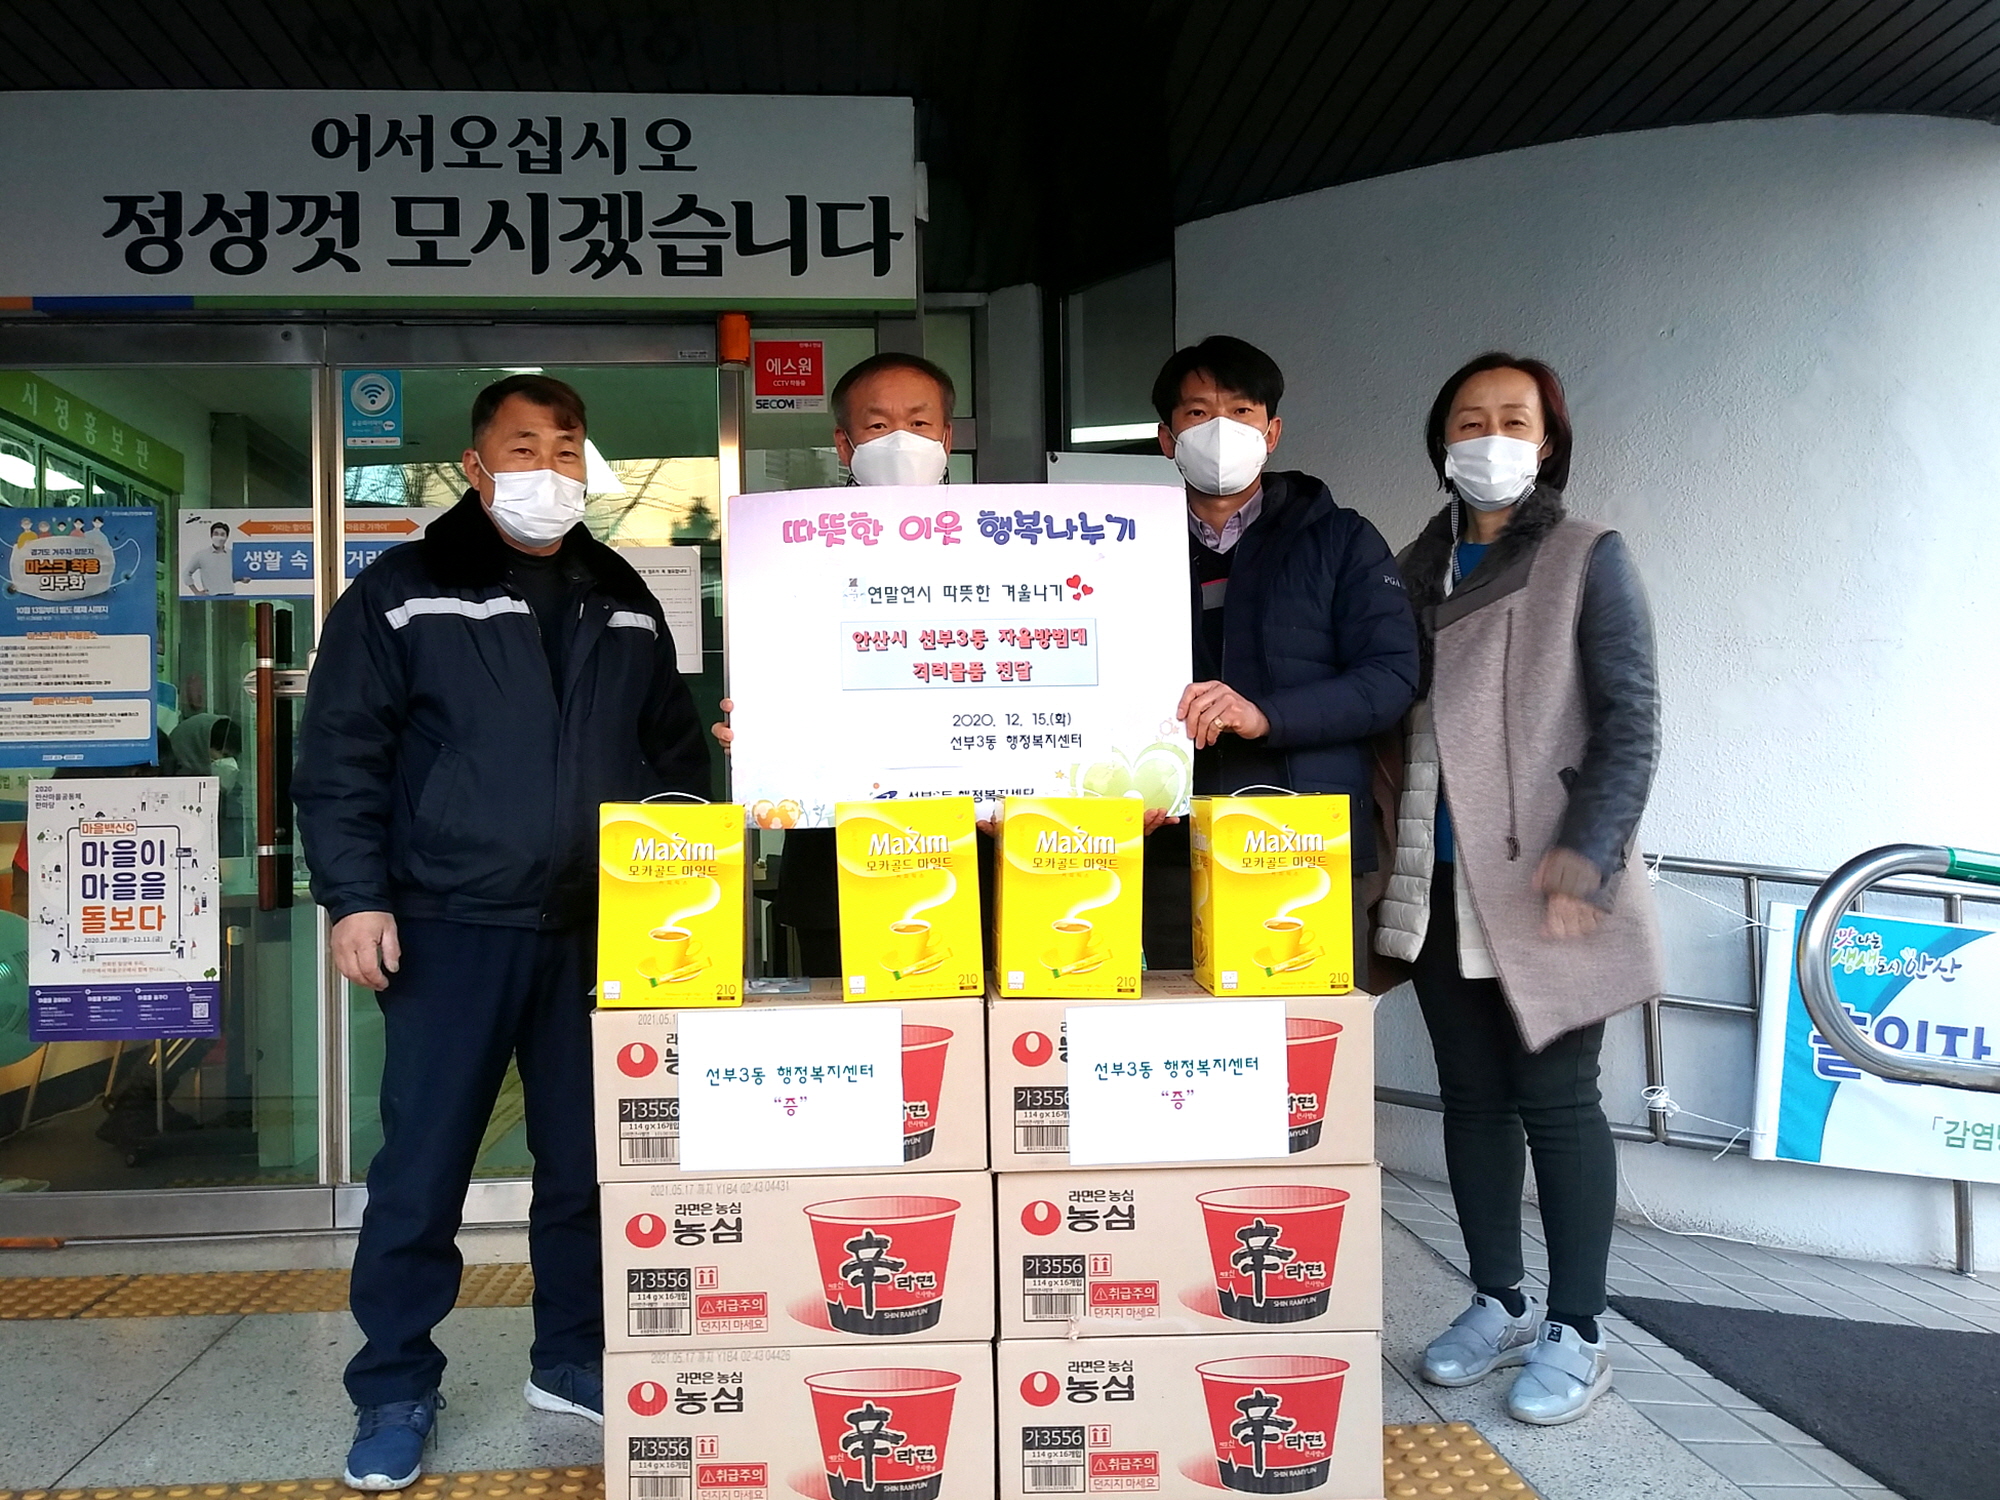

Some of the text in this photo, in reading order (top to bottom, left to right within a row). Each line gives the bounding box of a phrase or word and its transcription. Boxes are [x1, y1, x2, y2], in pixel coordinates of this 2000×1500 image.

[311, 114, 698, 176] 어서오십시오
[102, 189, 905, 280] 정성껏 모시겠습니다
[766, 358, 812, 376] 에스원
[755, 399, 795, 410] SECOM
[783, 510, 1137, 548] 따뜻한 이웃 행복나누기
[25, 558, 100, 575] 마스크 착용
[243, 550, 283, 572] 생활
[290, 550, 309, 570] 속
[40, 576, 86, 591] 의무화
[867, 581, 1063, 604] 연말연시 따뜻한 겨울나기
[852, 627, 1088, 652] 안산시 선부3동 자율방범대
[912, 660, 1033, 684] 격려물품 전달
[952, 713, 996, 728] 2020.
[1005, 713, 1023, 727] 12.
[950, 733, 1083, 751] 선부3동 행정복지센터
[82, 823, 126, 835] 마을백신
[868, 829, 950, 857] Maxim
[1035, 828, 1116, 855] Maxim
[1243, 827, 1325, 853] Maxim
[81, 839, 165, 868] 마을이
[631, 835, 716, 862] Maxim
[866, 857, 954, 872] 모카골드 마일드
[1032, 857, 1119, 872] 모카골드 마일드
[1242, 856, 1328, 869] 모카골드 마일드
[628, 865, 719, 879] 모카골드 마일드
[81, 871, 166, 901] 마을을
[81, 904, 166, 934] 돌보다
[1904, 952, 1963, 983] 안산
[958, 974, 978, 985] 210
[1116, 976, 1136, 988] 210
[1329, 972, 1350, 984] 210
[716, 984, 736, 996] 210
[706, 1063, 875, 1087] 선부3동 행정복지센터
[1094, 1057, 1259, 1081] 선부3동 행정복지센터
[622, 1101, 679, 1119] 가3556
[1068, 1189, 1134, 1203] 라면은 농심
[674, 1202, 742, 1216] 라면은 농심
[1066, 1204, 1135, 1233] 농심
[672, 1217, 743, 1246] 농심
[1026, 1258, 1083, 1275] 가3556
[1286, 1263, 1324, 1279] 라면
[630, 1272, 688, 1290] 가3556
[896, 1274, 935, 1290] 라면
[637, 1293, 651, 1301] 114
[1108, 1286, 1155, 1301] 취급주의
[715, 1297, 763, 1312] 취급주의
[1273, 1296, 1317, 1308] SHIN RAMYUN
[884, 1307, 928, 1319] SHIN RAMYUN
[1068, 1360, 1133, 1373] 라면은 농심
[676, 1371, 743, 1385] 라면은 농심
[1065, 1374, 1135, 1404] 농심
[674, 1386, 743, 1415] 농심
[1025, 1430, 1083, 1447] 가3556
[1286, 1433, 1324, 1449] 라면
[632, 1440, 689, 1458] 가3556
[896, 1448, 935, 1464] 라면
[1108, 1457, 1155, 1471] 취급주의
[1273, 1466, 1317, 1478] SHIN RAMYUN
[716, 1468, 763, 1483] 취급주의
[884, 1481, 928, 1493] SHIN RAMYUN
